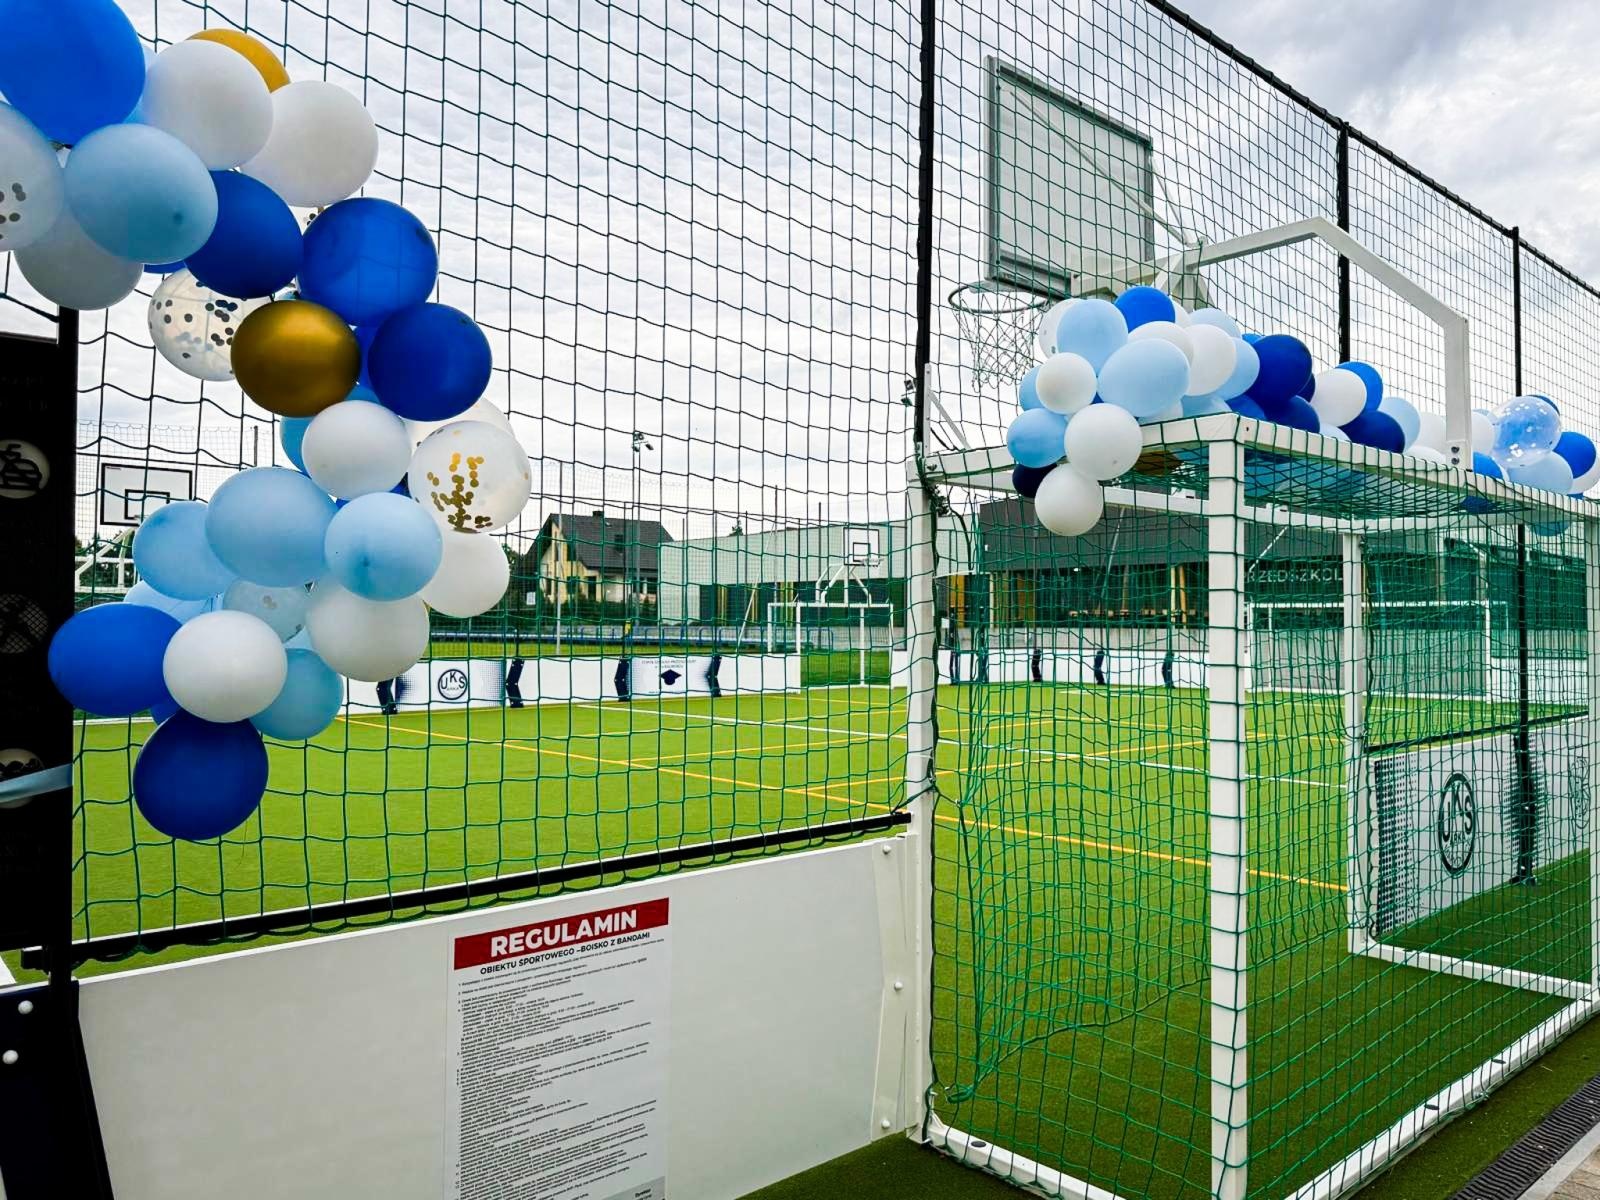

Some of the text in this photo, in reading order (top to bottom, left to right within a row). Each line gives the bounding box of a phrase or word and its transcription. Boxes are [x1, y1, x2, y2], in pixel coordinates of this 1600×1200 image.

[1244, 568, 1343, 583] RZEDSZKOL
[440, 671, 466, 690] UKS
[490, 909, 637, 958] REGULAMIN
[480, 960, 517, 975] OBIEKTU
[518, 947, 575, 967] SPORTOWEGO
[610, 938, 616, 947] Z
[617, 931, 650, 945] BANDAMI
